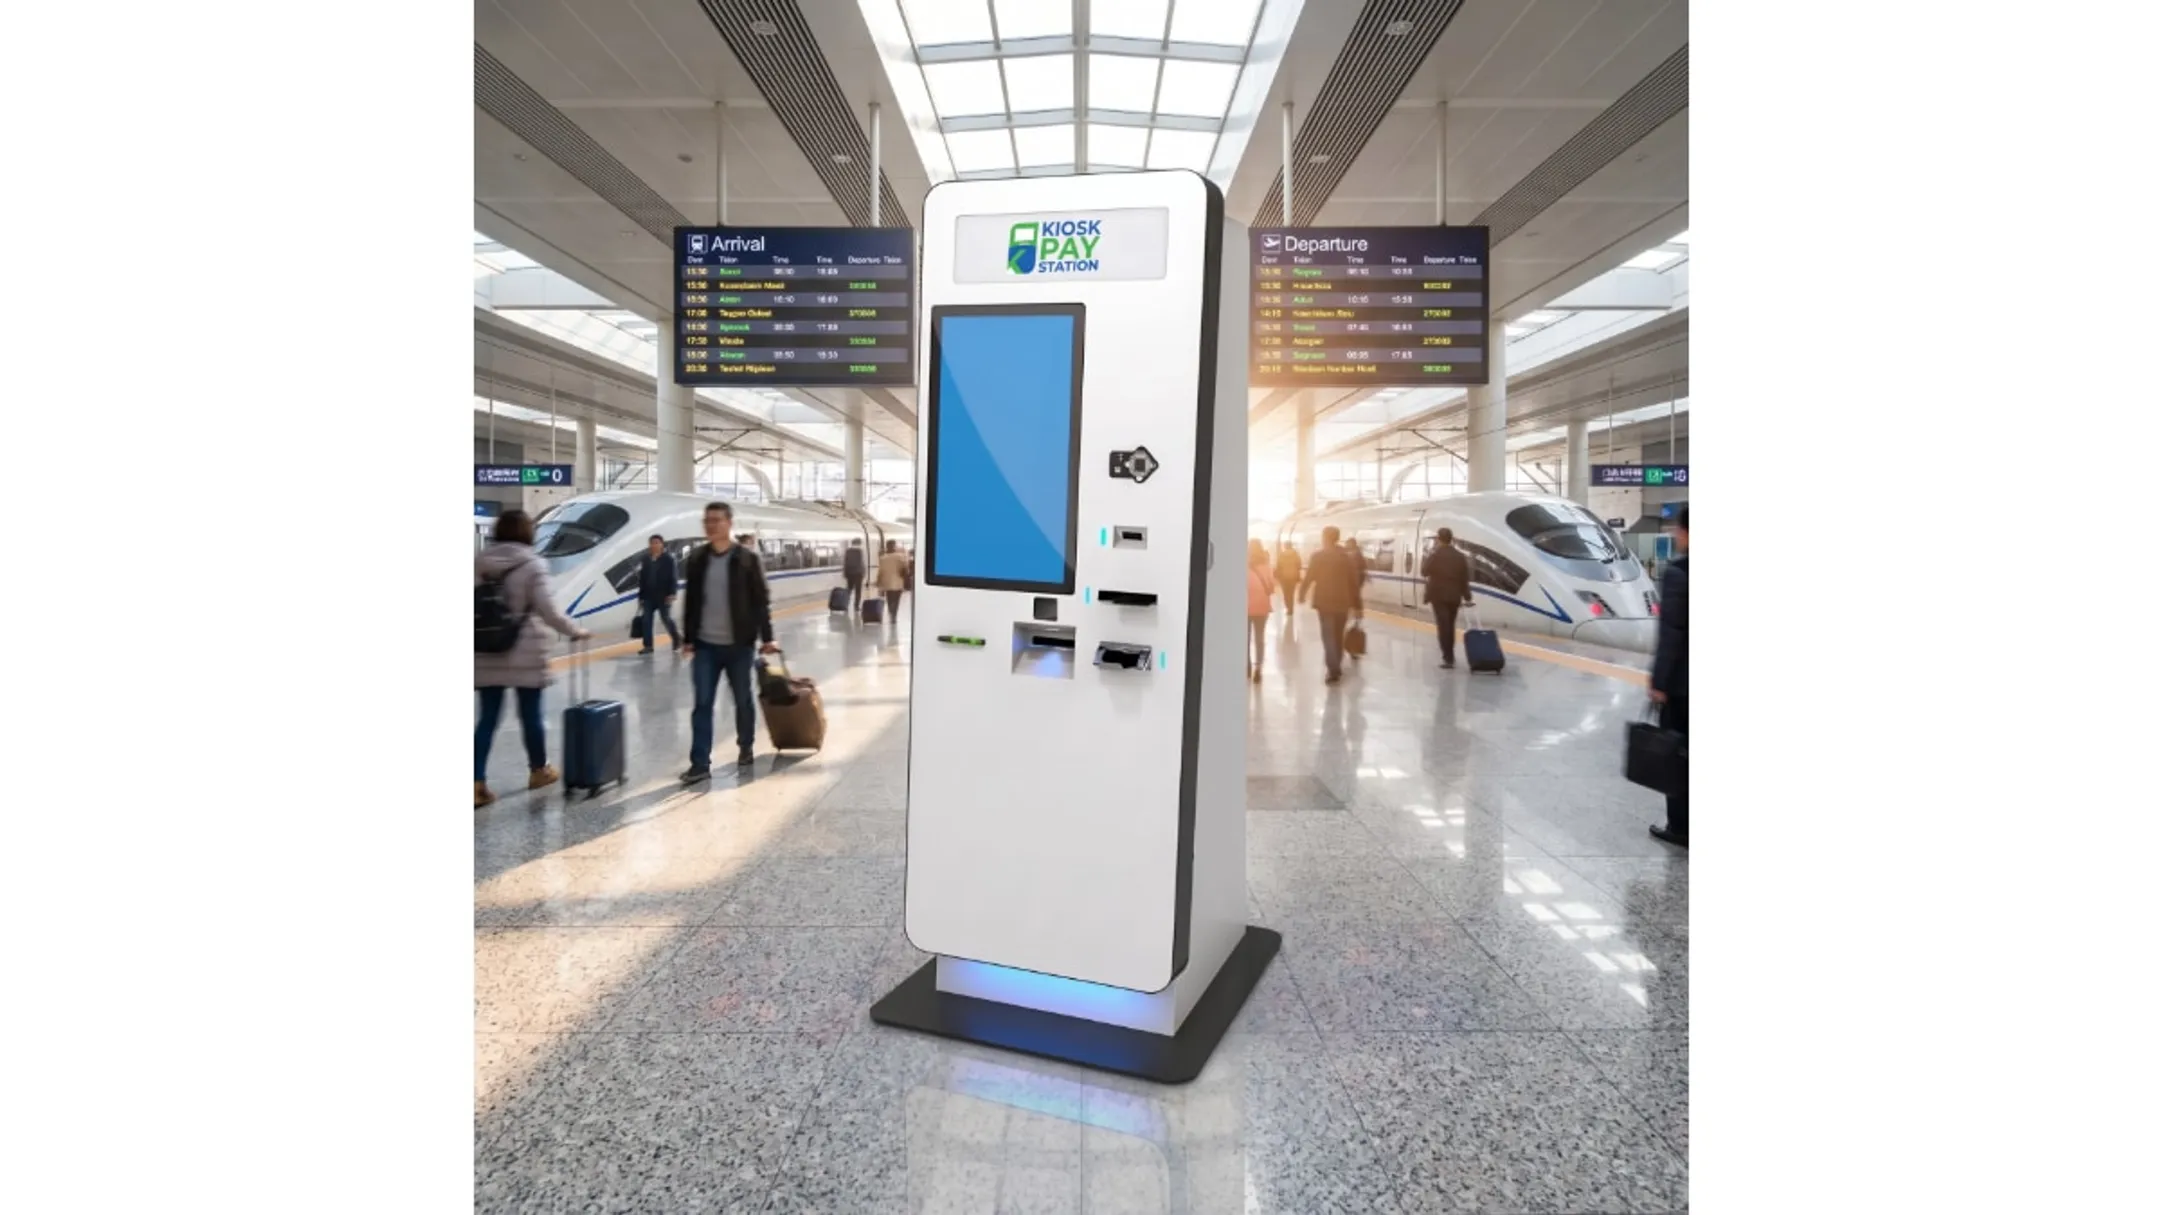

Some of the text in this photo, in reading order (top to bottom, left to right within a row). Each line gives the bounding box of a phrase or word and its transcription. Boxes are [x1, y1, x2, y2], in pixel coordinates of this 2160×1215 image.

[1042, 220, 1102, 236] KIOSK
[711, 236, 765, 251] Arrival
[1040, 236, 1100, 260] PAY
[1285, 236, 1368, 254] Departure
[1038, 260, 1099, 273] STATION
